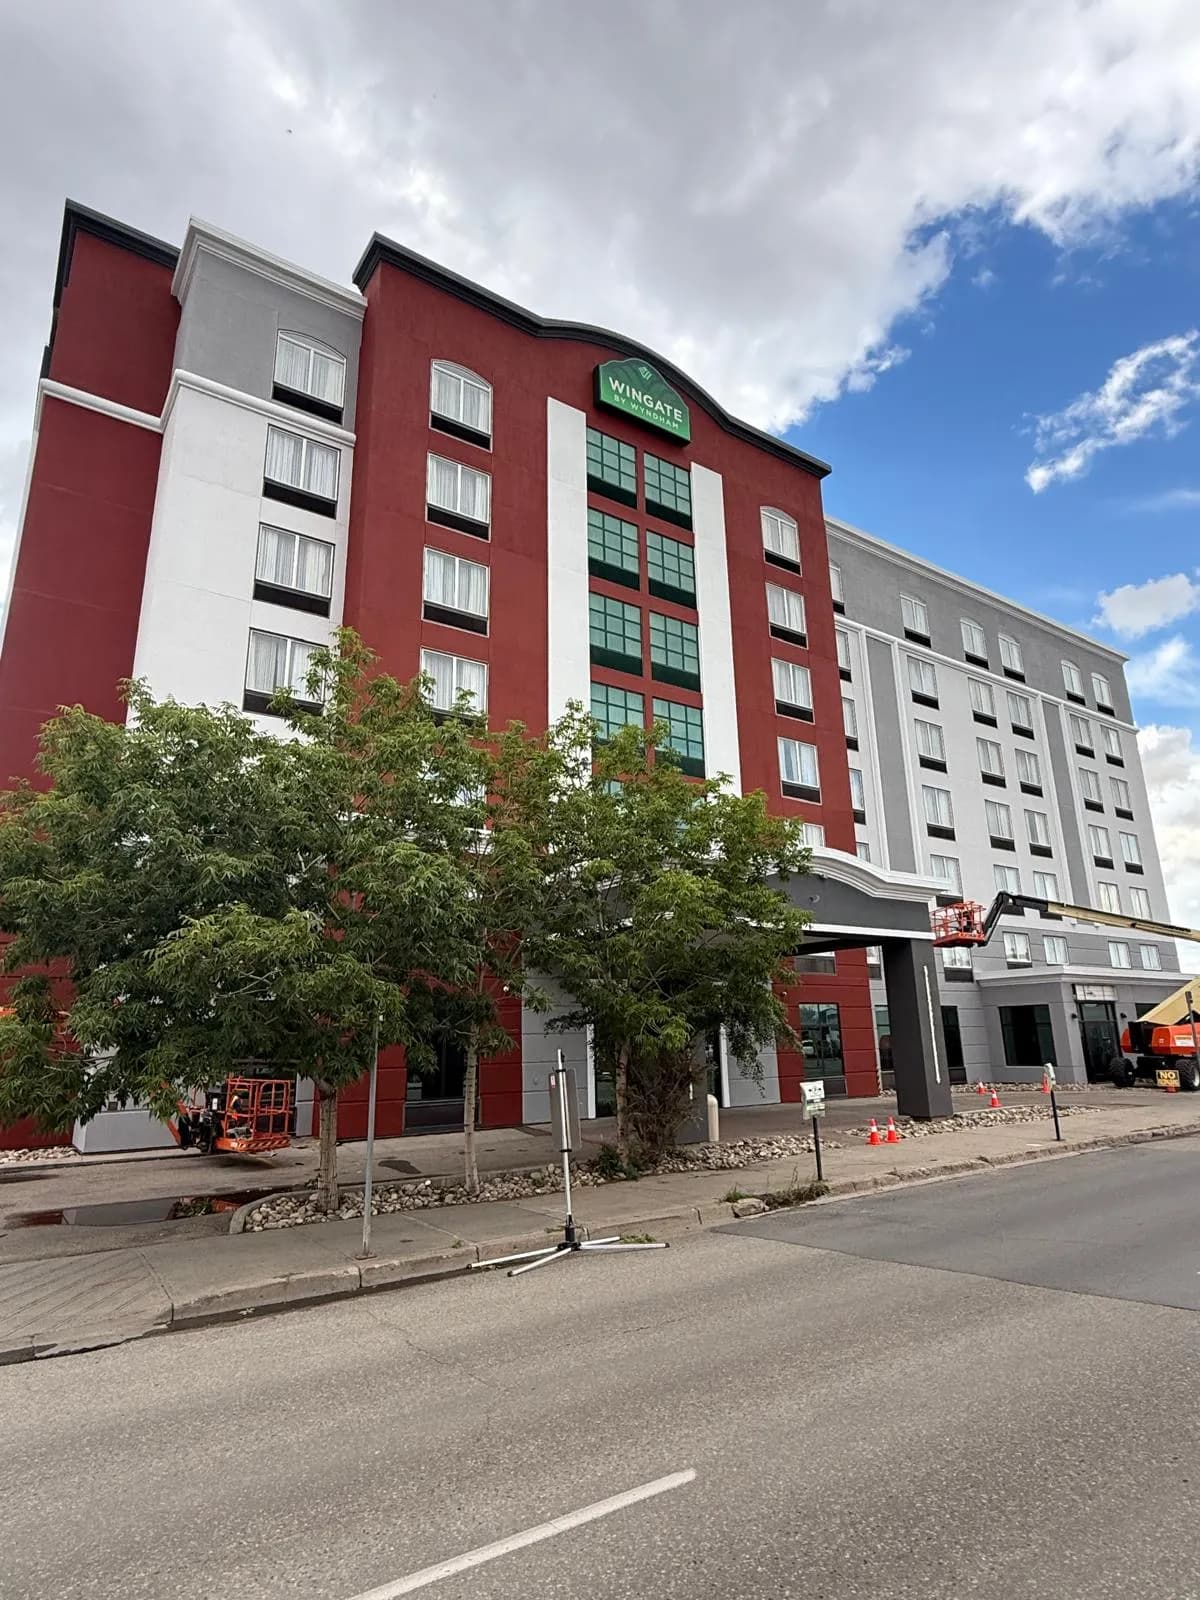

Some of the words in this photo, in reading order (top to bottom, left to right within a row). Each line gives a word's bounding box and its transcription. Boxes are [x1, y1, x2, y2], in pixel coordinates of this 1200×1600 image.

[608, 376, 683, 423] WINGATE
[614, 394, 626, 405] BY
[630, 402, 679, 430] WYNDHAM
[1159, 1071, 1176, 1079] NO
